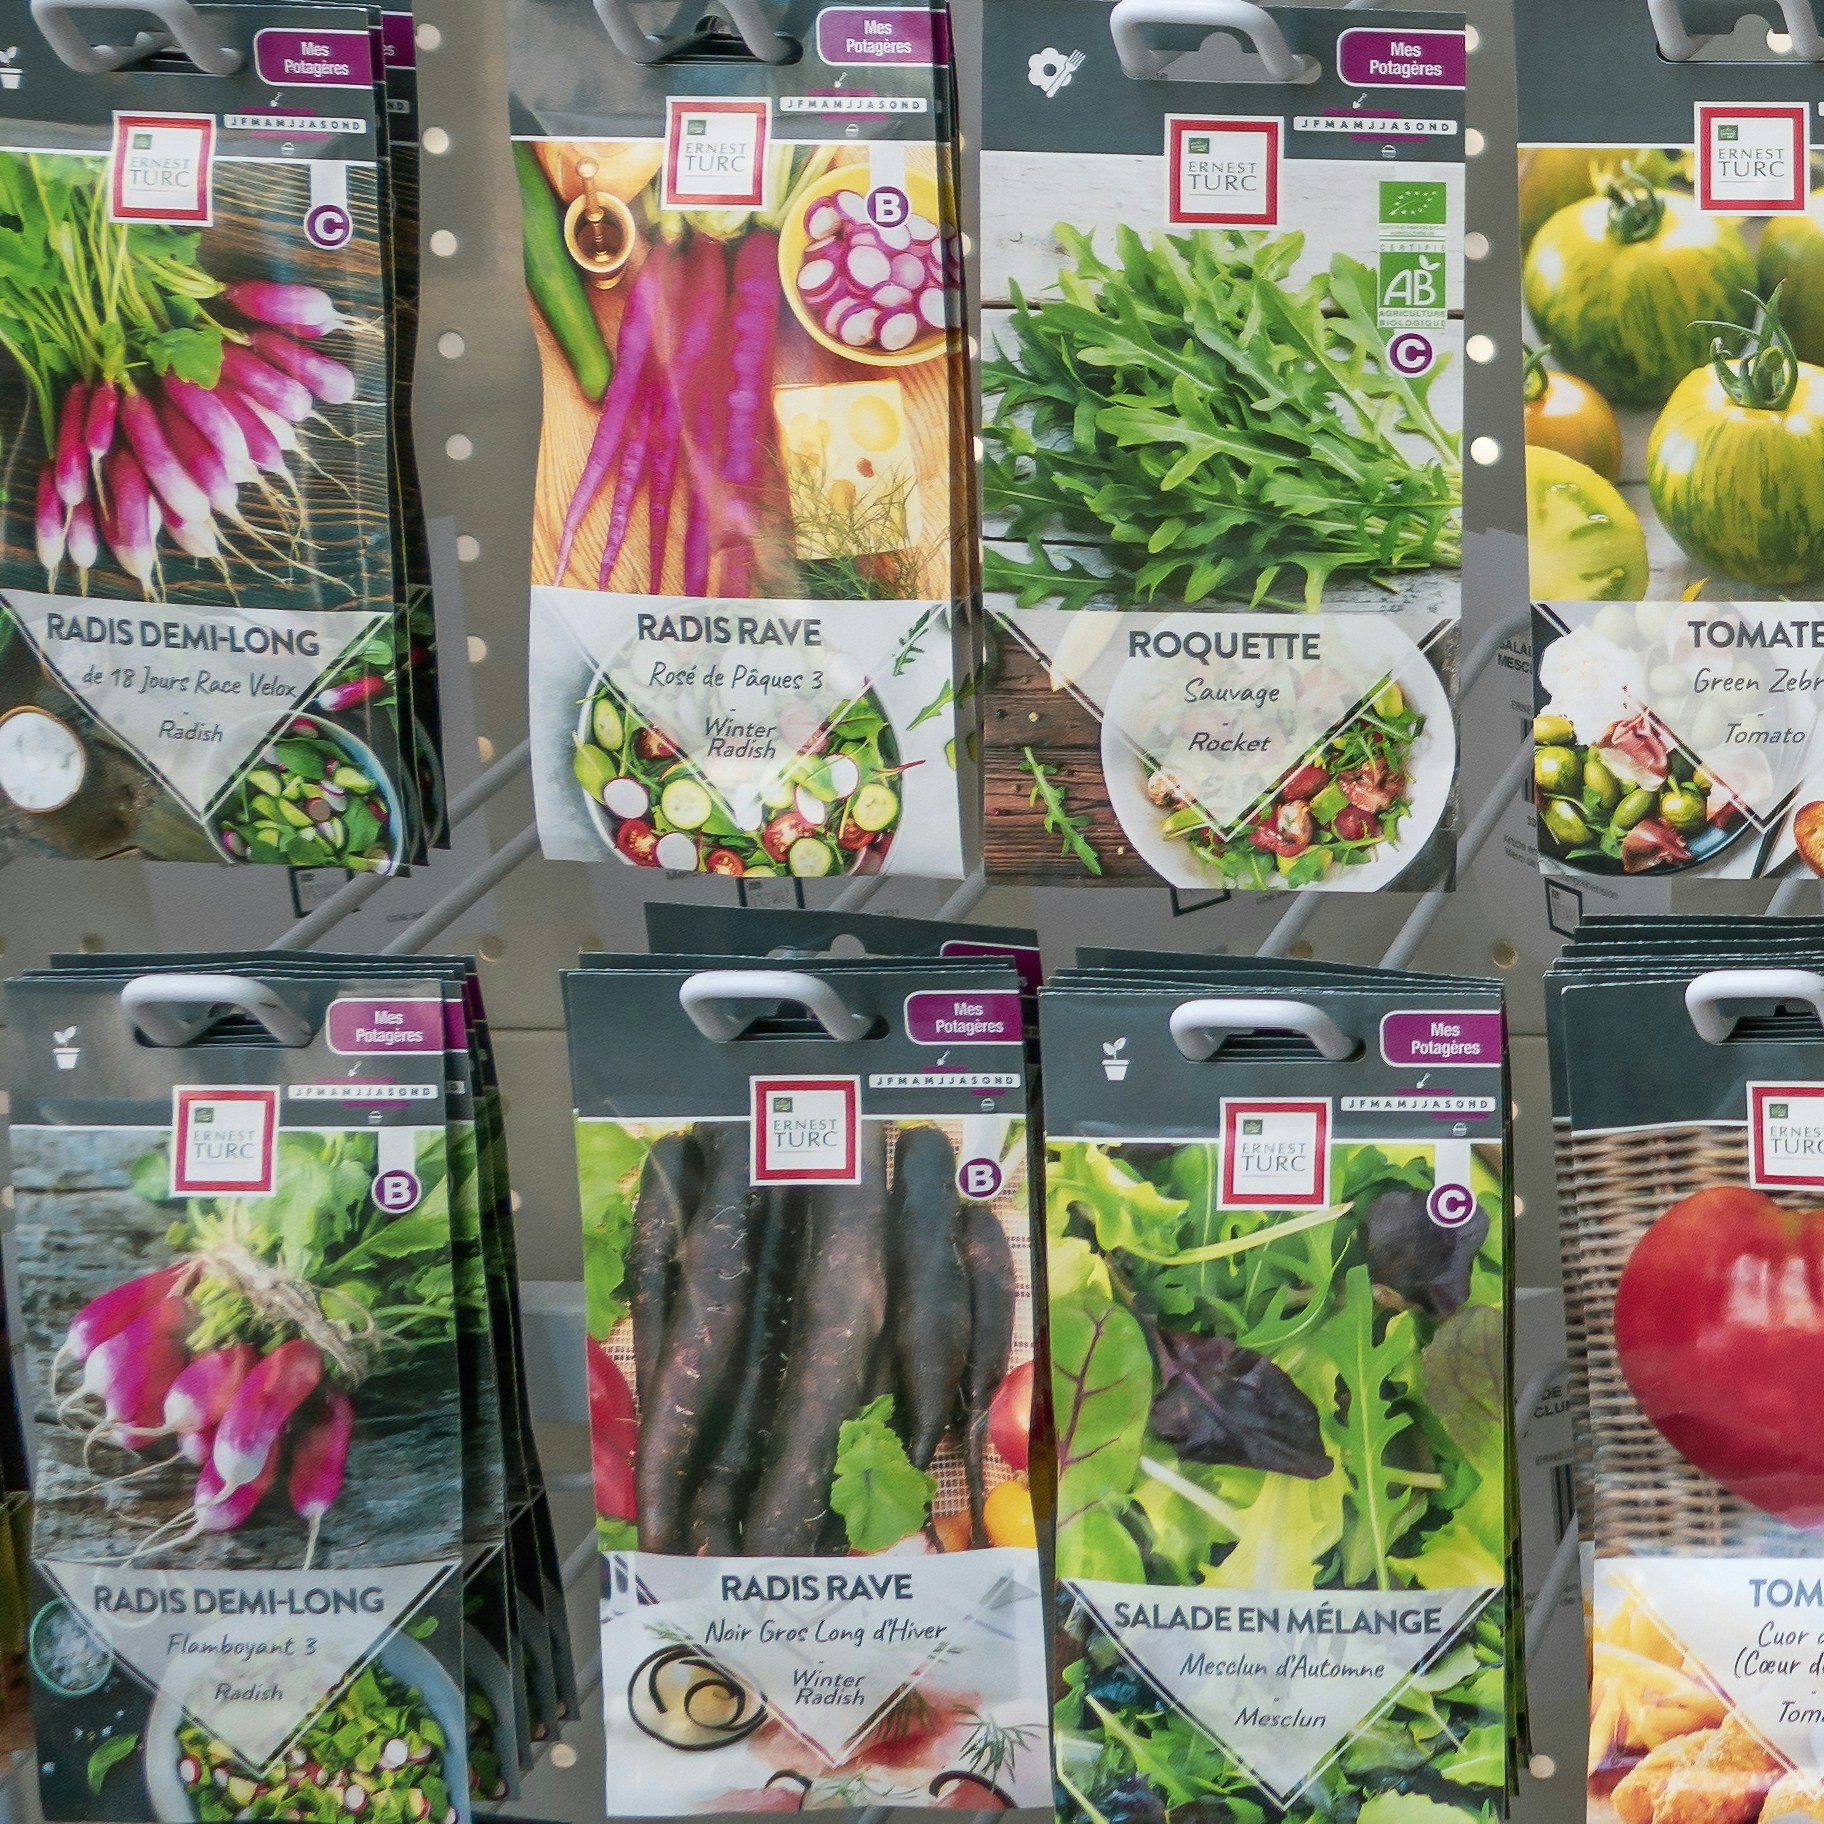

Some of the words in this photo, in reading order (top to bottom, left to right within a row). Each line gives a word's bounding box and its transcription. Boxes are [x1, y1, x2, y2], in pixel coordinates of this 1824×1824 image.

[1390, 42, 1422, 58] Mes
[1368, 58, 1442, 78] Potagères
[48, 613, 132, 648] RADIS
[140, 621, 319, 658] DEMI-LONG
[637, 613, 731, 645] RADIS
[738, 618, 822, 648] RAVE
[1128, 631, 1321, 662] ROQUETTE
[1694, 668, 1760, 692] Green
[708, 736, 776, 760] Radish
[1189, 730, 1270, 753] Rocket
[721, 1575, 820, 1602] RADIS
[827, 1572, 913, 1600] RAVE
[94, 1586, 185, 1613] RADIS
[194, 1588, 385, 1615] DEMI-LONG
[1114, 1603, 1231, 1633] SALADE
[1237, 1606, 1279, 1632] EN
[1286, 1598, 1441, 1635] MÉLANGE
[1757, 1624, 1808, 1645] Cuor
[793, 1669, 865, 1689] Winter
[792, 1688, 865, 1707] Radish
[1235, 1707, 1326, 1729] Mesclun
